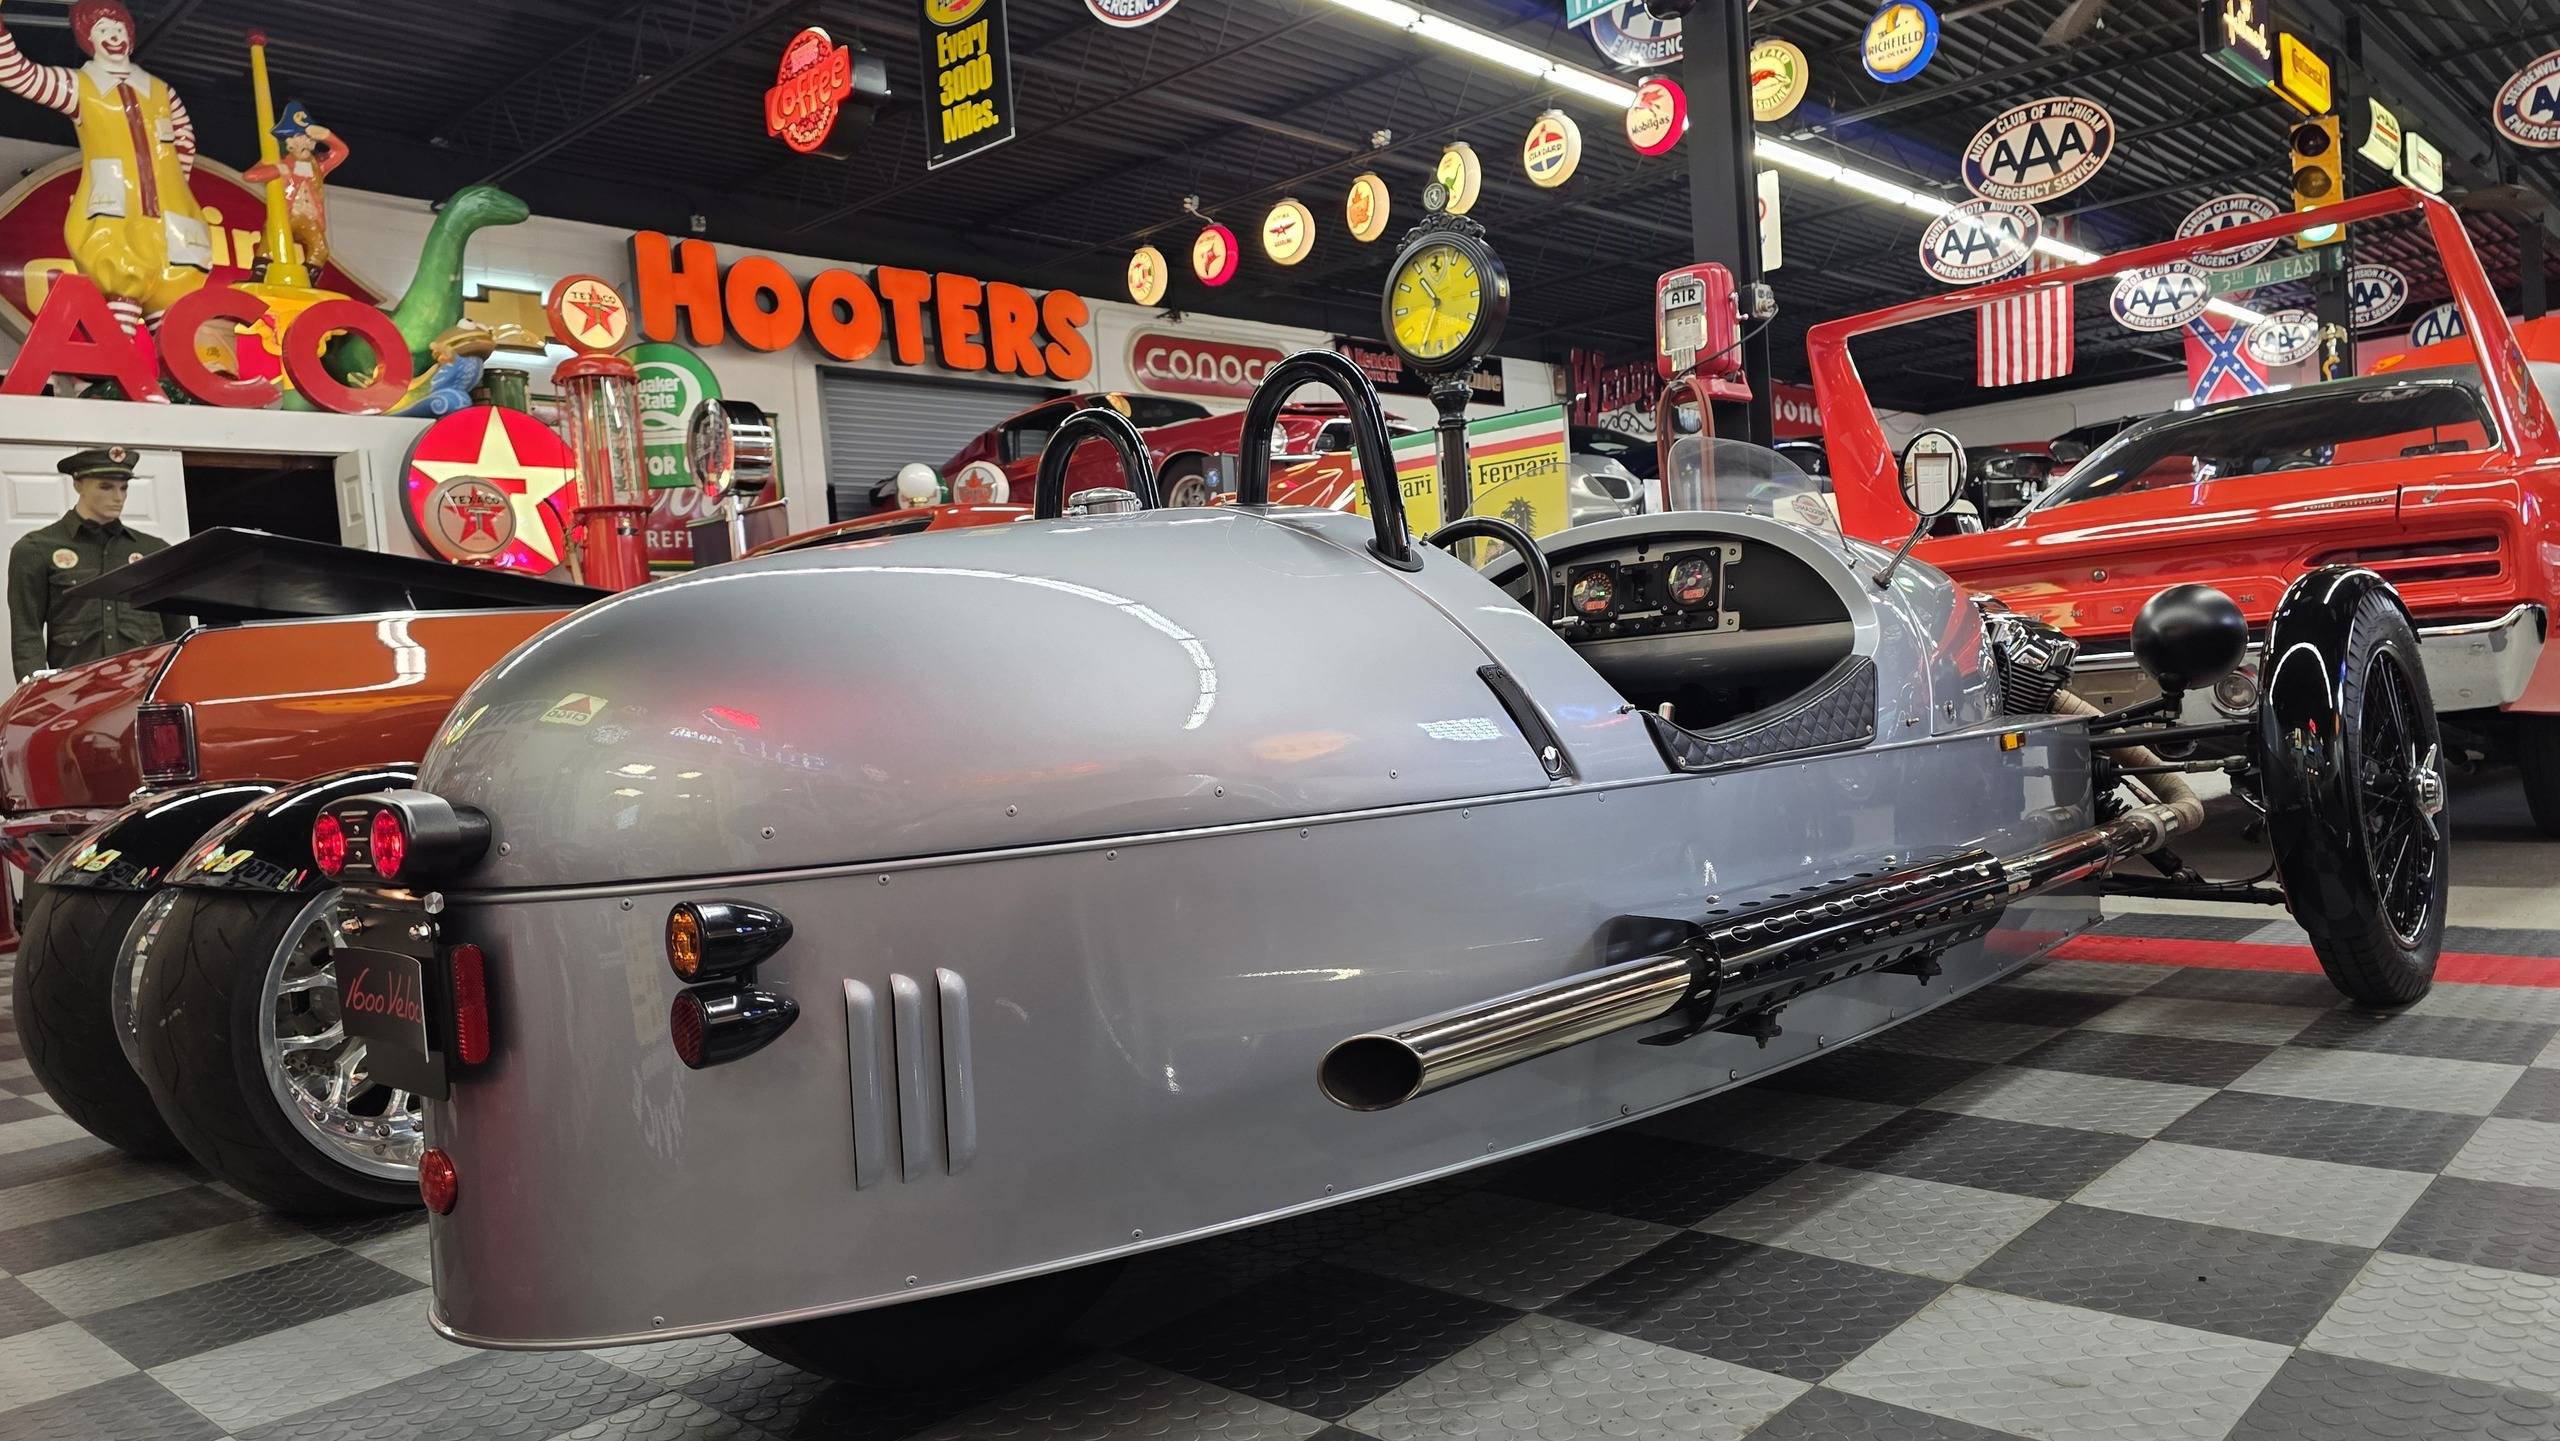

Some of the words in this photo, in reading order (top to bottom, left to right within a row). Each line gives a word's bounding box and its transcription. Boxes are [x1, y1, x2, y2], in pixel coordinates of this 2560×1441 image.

[1098, 0, 1160, 16] ERGENC
[937, 19, 988, 67] Every
[1610, 34, 1683, 60] EMERGENC
[1868, 31, 1923, 55] RICHFIELD
[771, 55, 845, 130] Coffee
[939, 53, 993, 106] 3000
[2503, 56, 2560, 107] STEUBENVIL
[942, 99, 999, 144] Miles.
[1632, 116, 1670, 134] Mobilgas
[1969, 133, 1993, 162] AUTO
[1996, 112, 2027, 134] CLUB
[2031, 105, 2047, 120] OF
[2051, 102, 2107, 132] MICHIGAN
[1988, 121, 2088, 184] AAA
[1979, 179, 2051, 200] EMERGENCY
[2055, 152, 2100, 192] SERVICE
[1925, 221, 1947, 250] SOUTH
[1947, 202, 1986, 223] DAKOTA
[1941, 216, 2021, 265] AAA
[2240, 243, 2268, 261] SERV
[1932, 260, 1991, 279] EMERGENCY
[2145, 264, 2171, 278] CLUB
[2173, 263, 2187, 272] OF
[2223, 271, 2245, 292] 5TH
[2284, 254, 2320, 278] EAST
[571, 291, 617, 304] TEXACO
[630, 230, 1094, 381] HOOTERS
[1671, 288, 1696, 305] AIR
[2130, 276, 2198, 315] AAA
[2355, 282, 2384, 308] AA
[2122, 311, 2174, 326] EMERGENCY
[0, 273, 413, 416] ACO
[1354, 347, 1404, 373] Kendall
[638, 376, 681, 393] uaker
[1366, 371, 1387, 383] OTOR
[640, 392, 676, 410] State
[1478, 451, 1559, 486] Ferrari
[450, 494, 500, 506] TEXACO
[345, 967, 386, 1014] 1600
